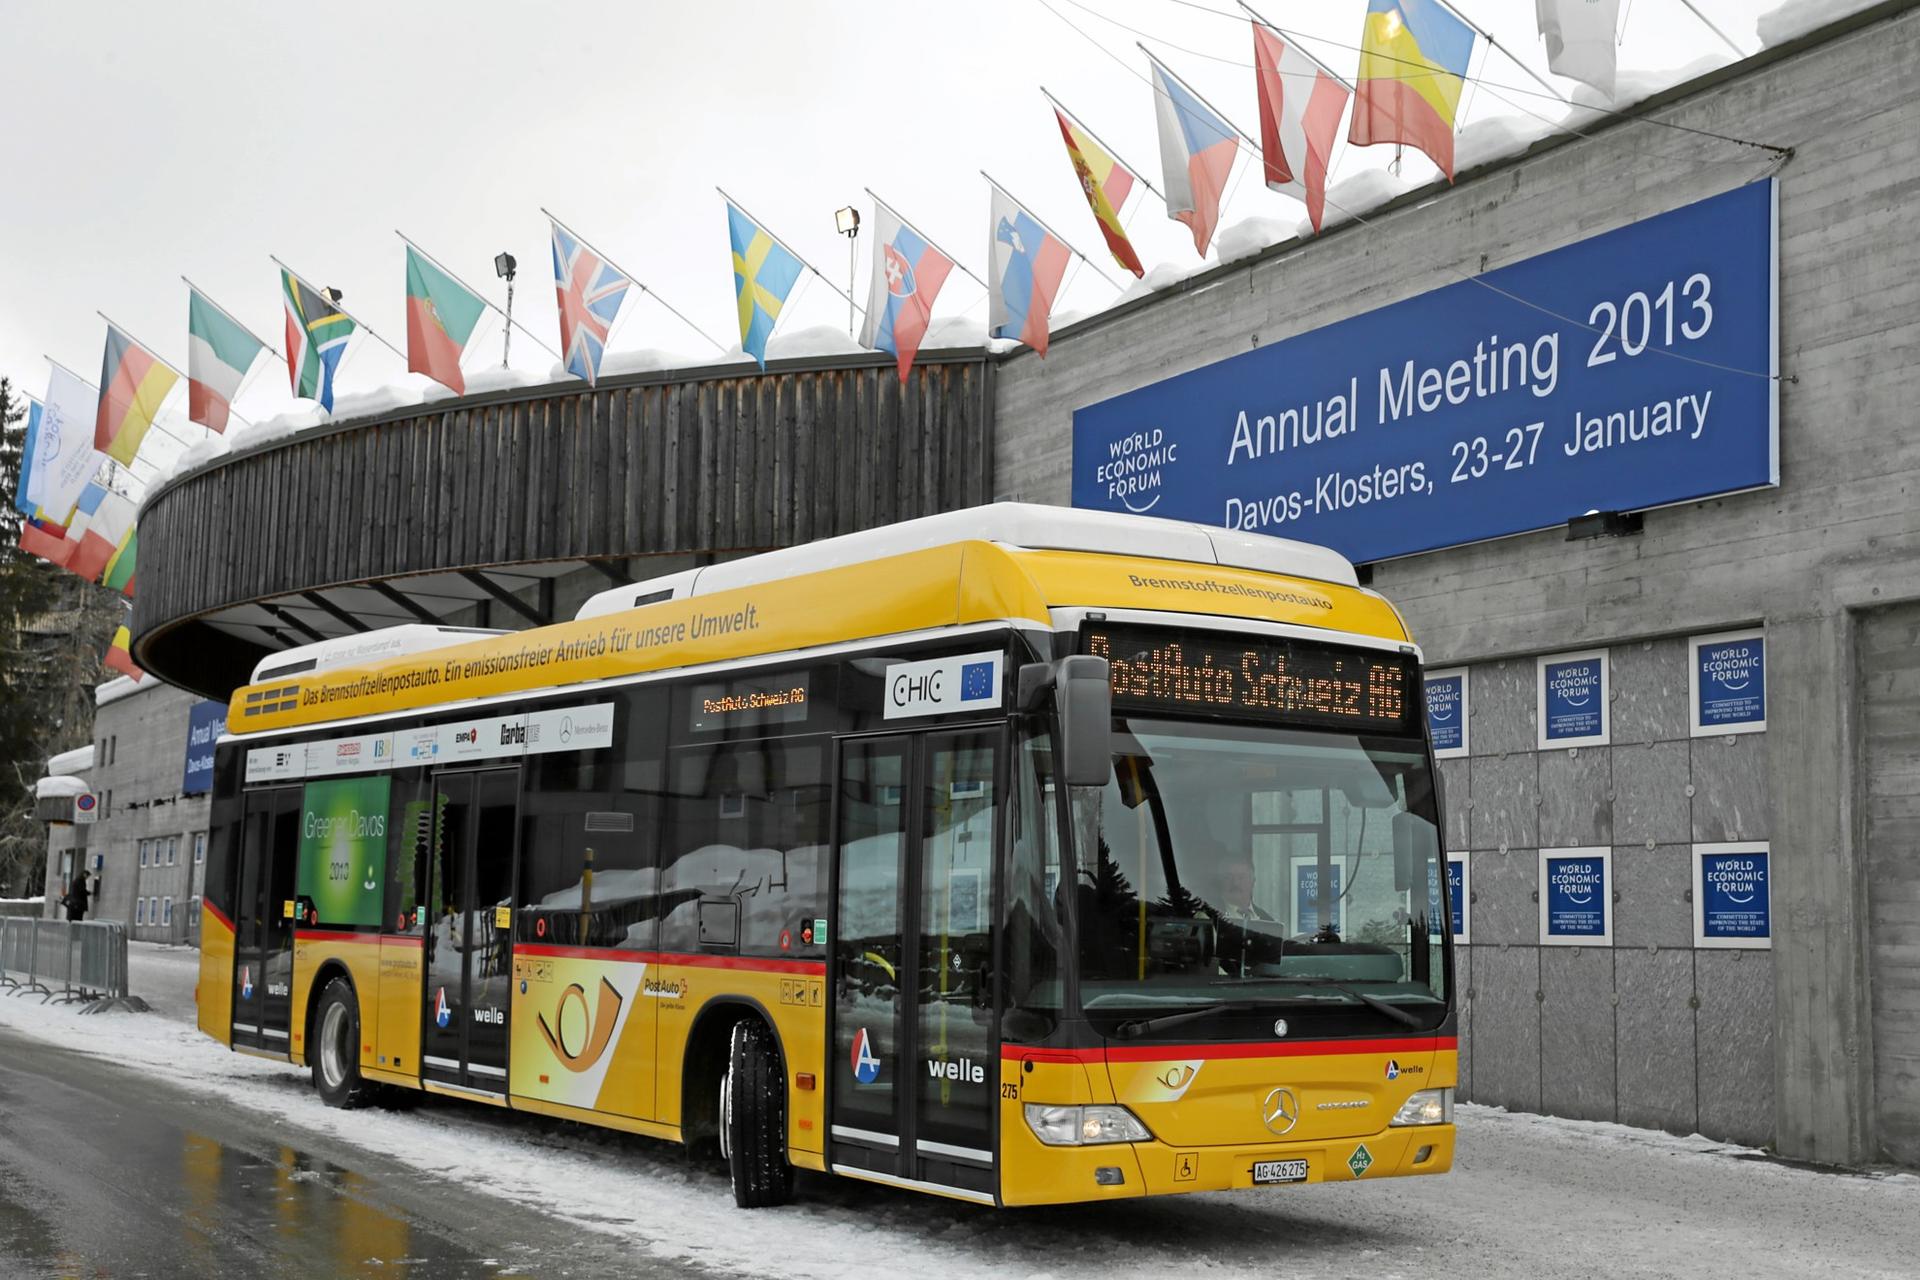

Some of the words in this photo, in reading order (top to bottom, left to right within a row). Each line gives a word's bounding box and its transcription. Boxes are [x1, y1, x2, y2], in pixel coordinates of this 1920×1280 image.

[1227, 377, 1357, 465] Annual
[1379, 332, 1558, 424] Meeting
[1587, 273, 1713, 367] 2013
[1110, 428, 1163, 458] WORLD
[1097, 444, 1177, 482] ECONOMIC
[1225, 461, 1433, 530] Davos-Klosters,
[1451, 421, 1544, 483] 23-27
[1564, 390, 1712, 456] January
[1109, 470, 1161, 499] FORUM
[1128, 575, 1333, 610] Brennstoffzellenpostauto
[303, 687, 320, 706] Das
[321, 666, 441, 701] Brennstoffzellenpostauto.
[444, 660, 461, 682] Ein
[464, 643, 551, 679] emissionsfreier
[555, 631, 606, 663] Antrieb
[610, 628, 632, 652] für
[635, 621, 686, 650] unsere
[690, 602, 760, 640] Umwelt.
[1712, 648, 1749, 660] WORLD
[1703, 657, 1760, 672] ECONOMIC
[1091, 635, 1233, 703] PostAuto
[1241, 651, 1361, 715] Schweiz
[1368, 664, 1402, 718] AG
[1557, 667, 1589, 678] WORLD
[1712, 670, 1749, 682] FORUM
[893, 669, 943, 707] CHIC
[1550, 675, 1598, 689] ECONOMIC
[1426, 692, 1460, 704] ONOMIC
[1557, 687, 1590, 698] FORUM
[704, 695, 748, 713] PostAuto
[749, 690, 789, 707] Schweiz
[790, 687, 805, 703] AG
[1428, 703, 1452, 713] ORUM
[304, 811, 348, 839] Greener
[350, 809, 384, 837] Davos
[1559, 865, 1591, 873] WORLD
[1716, 861, 1753, 870] WORLD
[1552, 874, 1600, 884] ECONOMIC
[1707, 871, 1764, 881] ECONOMIC
[1559, 885, 1591, 893] FORUM
[1716, 882, 1754, 892] FORUM
[268, 982, 288, 996] welle
[645, 978, 679, 994] PostAuto
[474, 1007, 504, 1024] welle
[928, 1058, 984, 1083] welle
[1400, 1065, 1424, 1074] welle
[1002, 1083, 1018, 1100] 275
[1352, 1160, 1368, 1170] GAS
